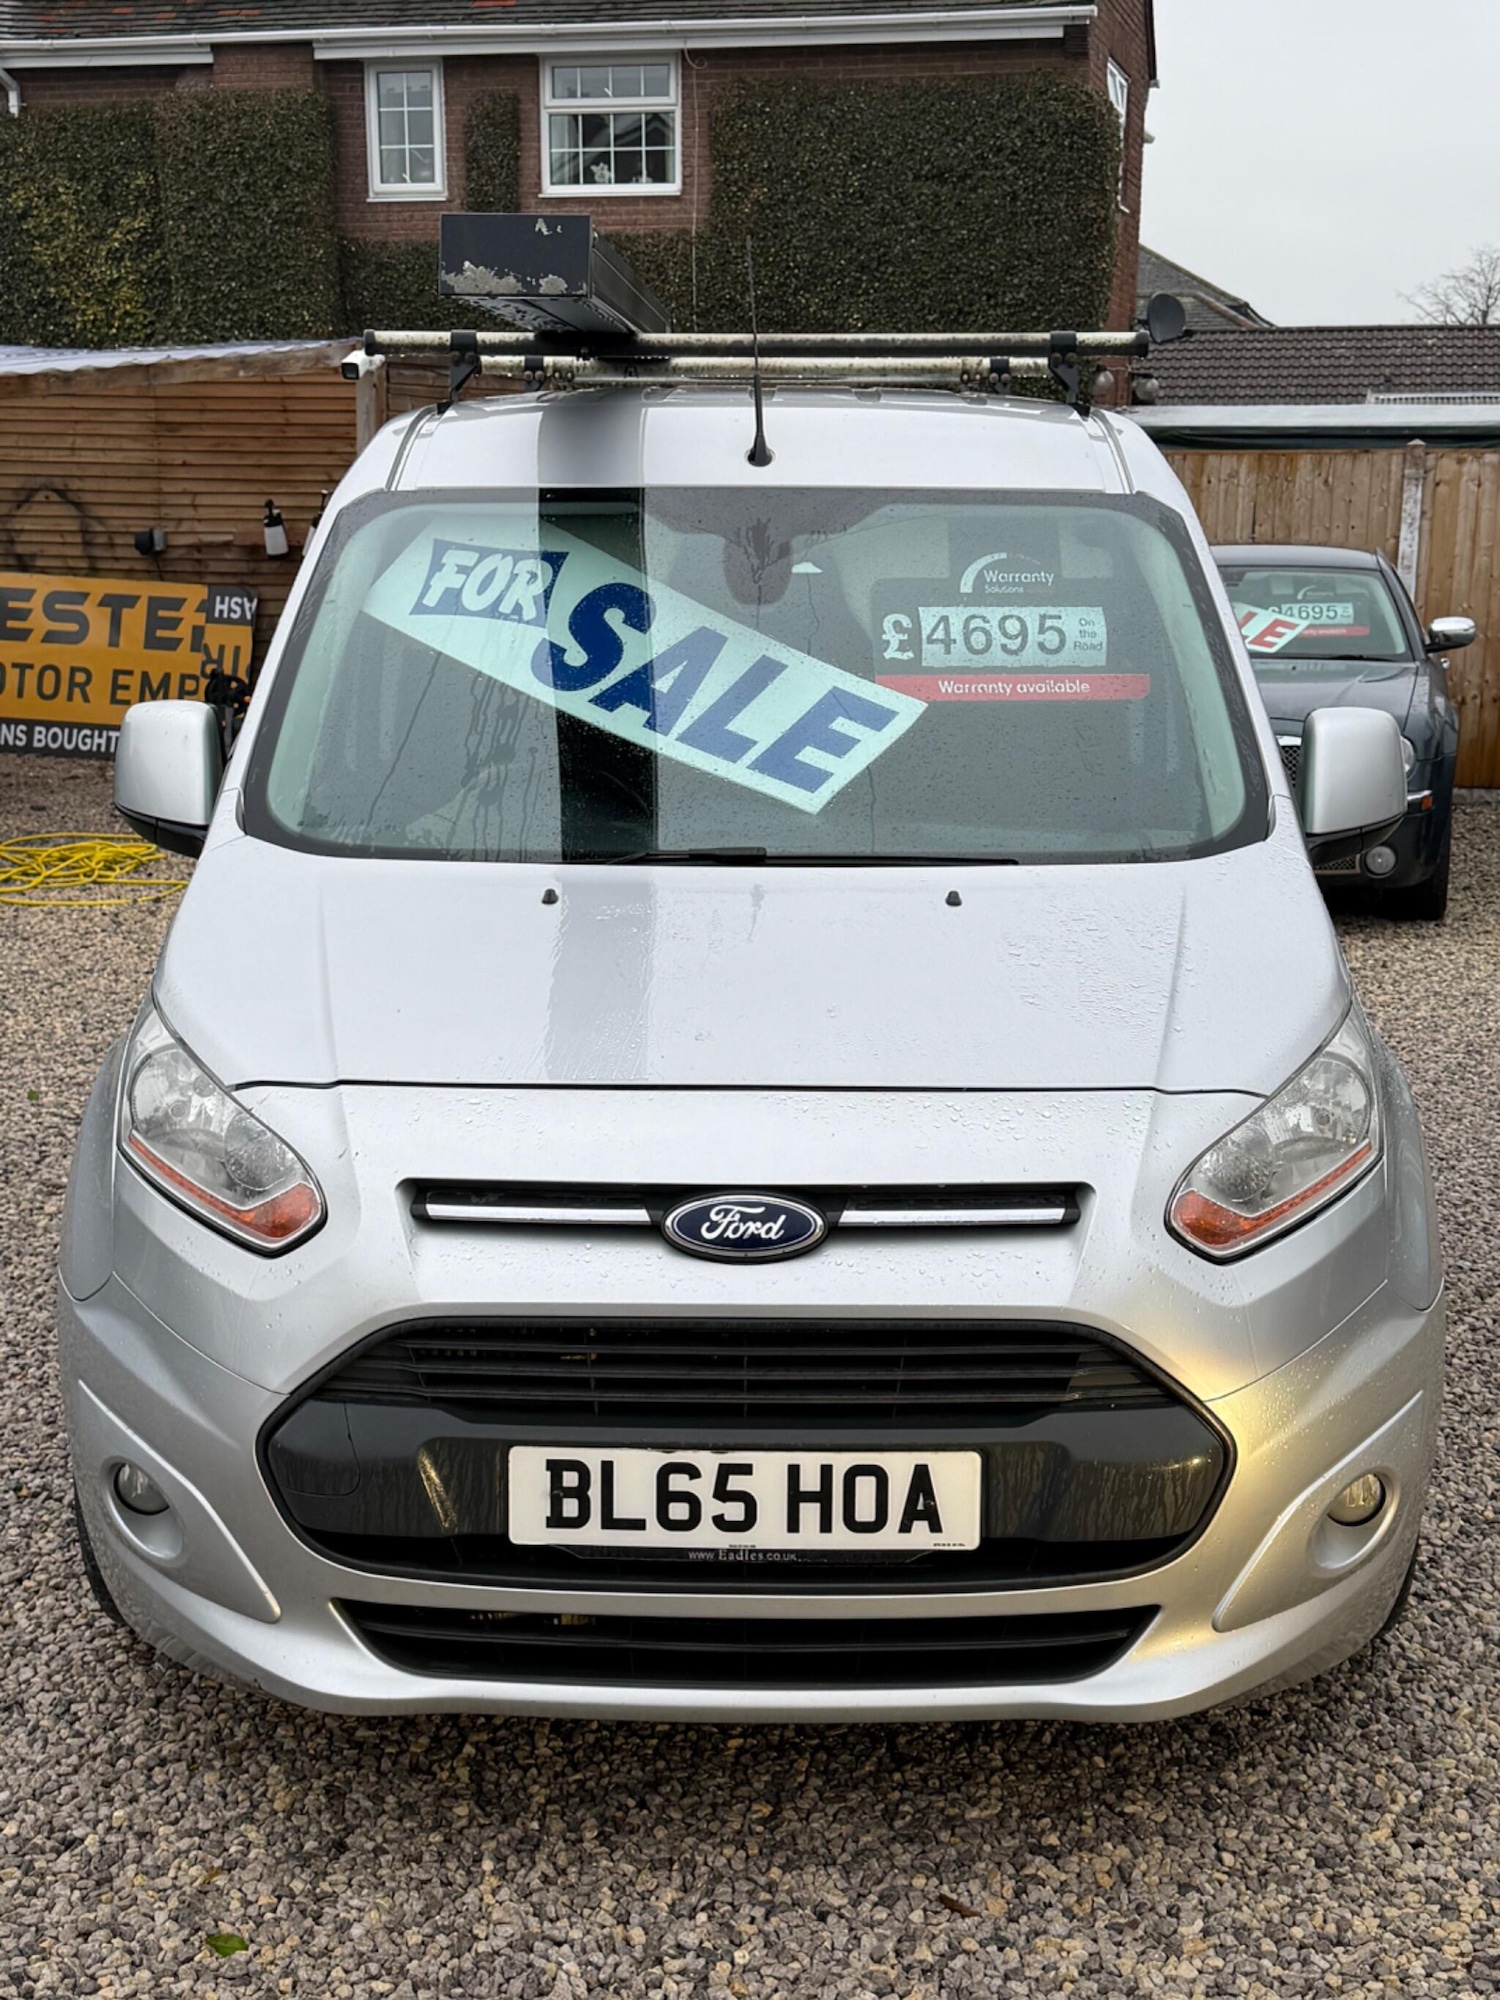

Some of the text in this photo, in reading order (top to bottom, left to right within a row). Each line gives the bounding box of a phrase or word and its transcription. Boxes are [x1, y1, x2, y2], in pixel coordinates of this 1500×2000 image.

[984, 569, 1054, 586] Warranty
[985, 585, 1024, 594] Solutions
[1079, 618, 1095, 626] On
[882, 613, 1067, 660] £4695
[1079, 629, 1097, 639] the
[1074, 641, 1103, 652] Road
[422, 549, 898, 794] FOR SALE
[938, 680, 1091, 696] Warranty available
[33, 725, 120, 753] BOUGHT
[700, 1204, 787, 1240] Ford
[545, 1458, 943, 1534] BL65 HOA
